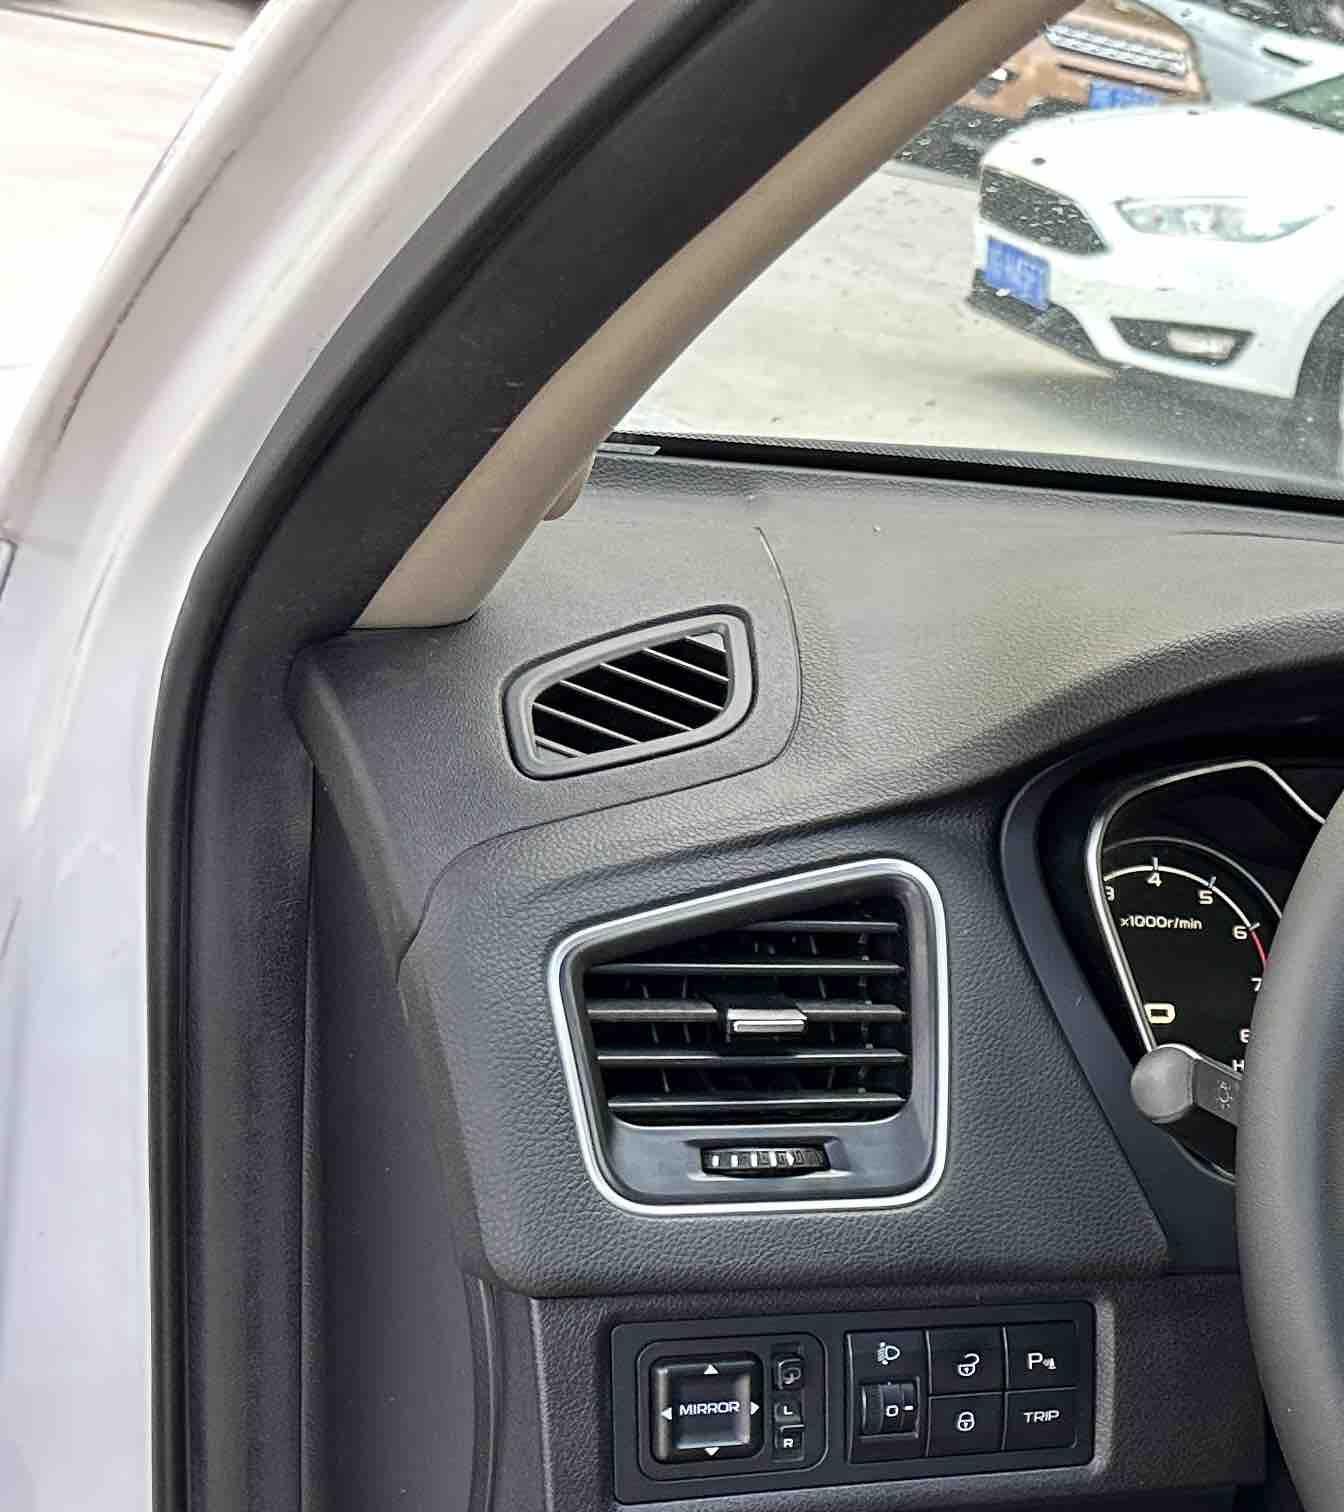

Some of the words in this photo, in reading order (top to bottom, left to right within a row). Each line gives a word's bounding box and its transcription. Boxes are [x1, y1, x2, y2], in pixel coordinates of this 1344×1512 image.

[1147, 872, 1163, 887] 4
[1199, 889, 1214, 905] 5
[1233, 925, 1249, 940] 6
[1250, 977, 1263, 992] 7
[1232, 1059, 1245, 1073] H
[679, 1401, 741, 1416] MIRROR
[783, 1405, 793, 1415] L
[1023, 1409, 1060, 1424] TRIP
[783, 1438, 794, 1448] R
